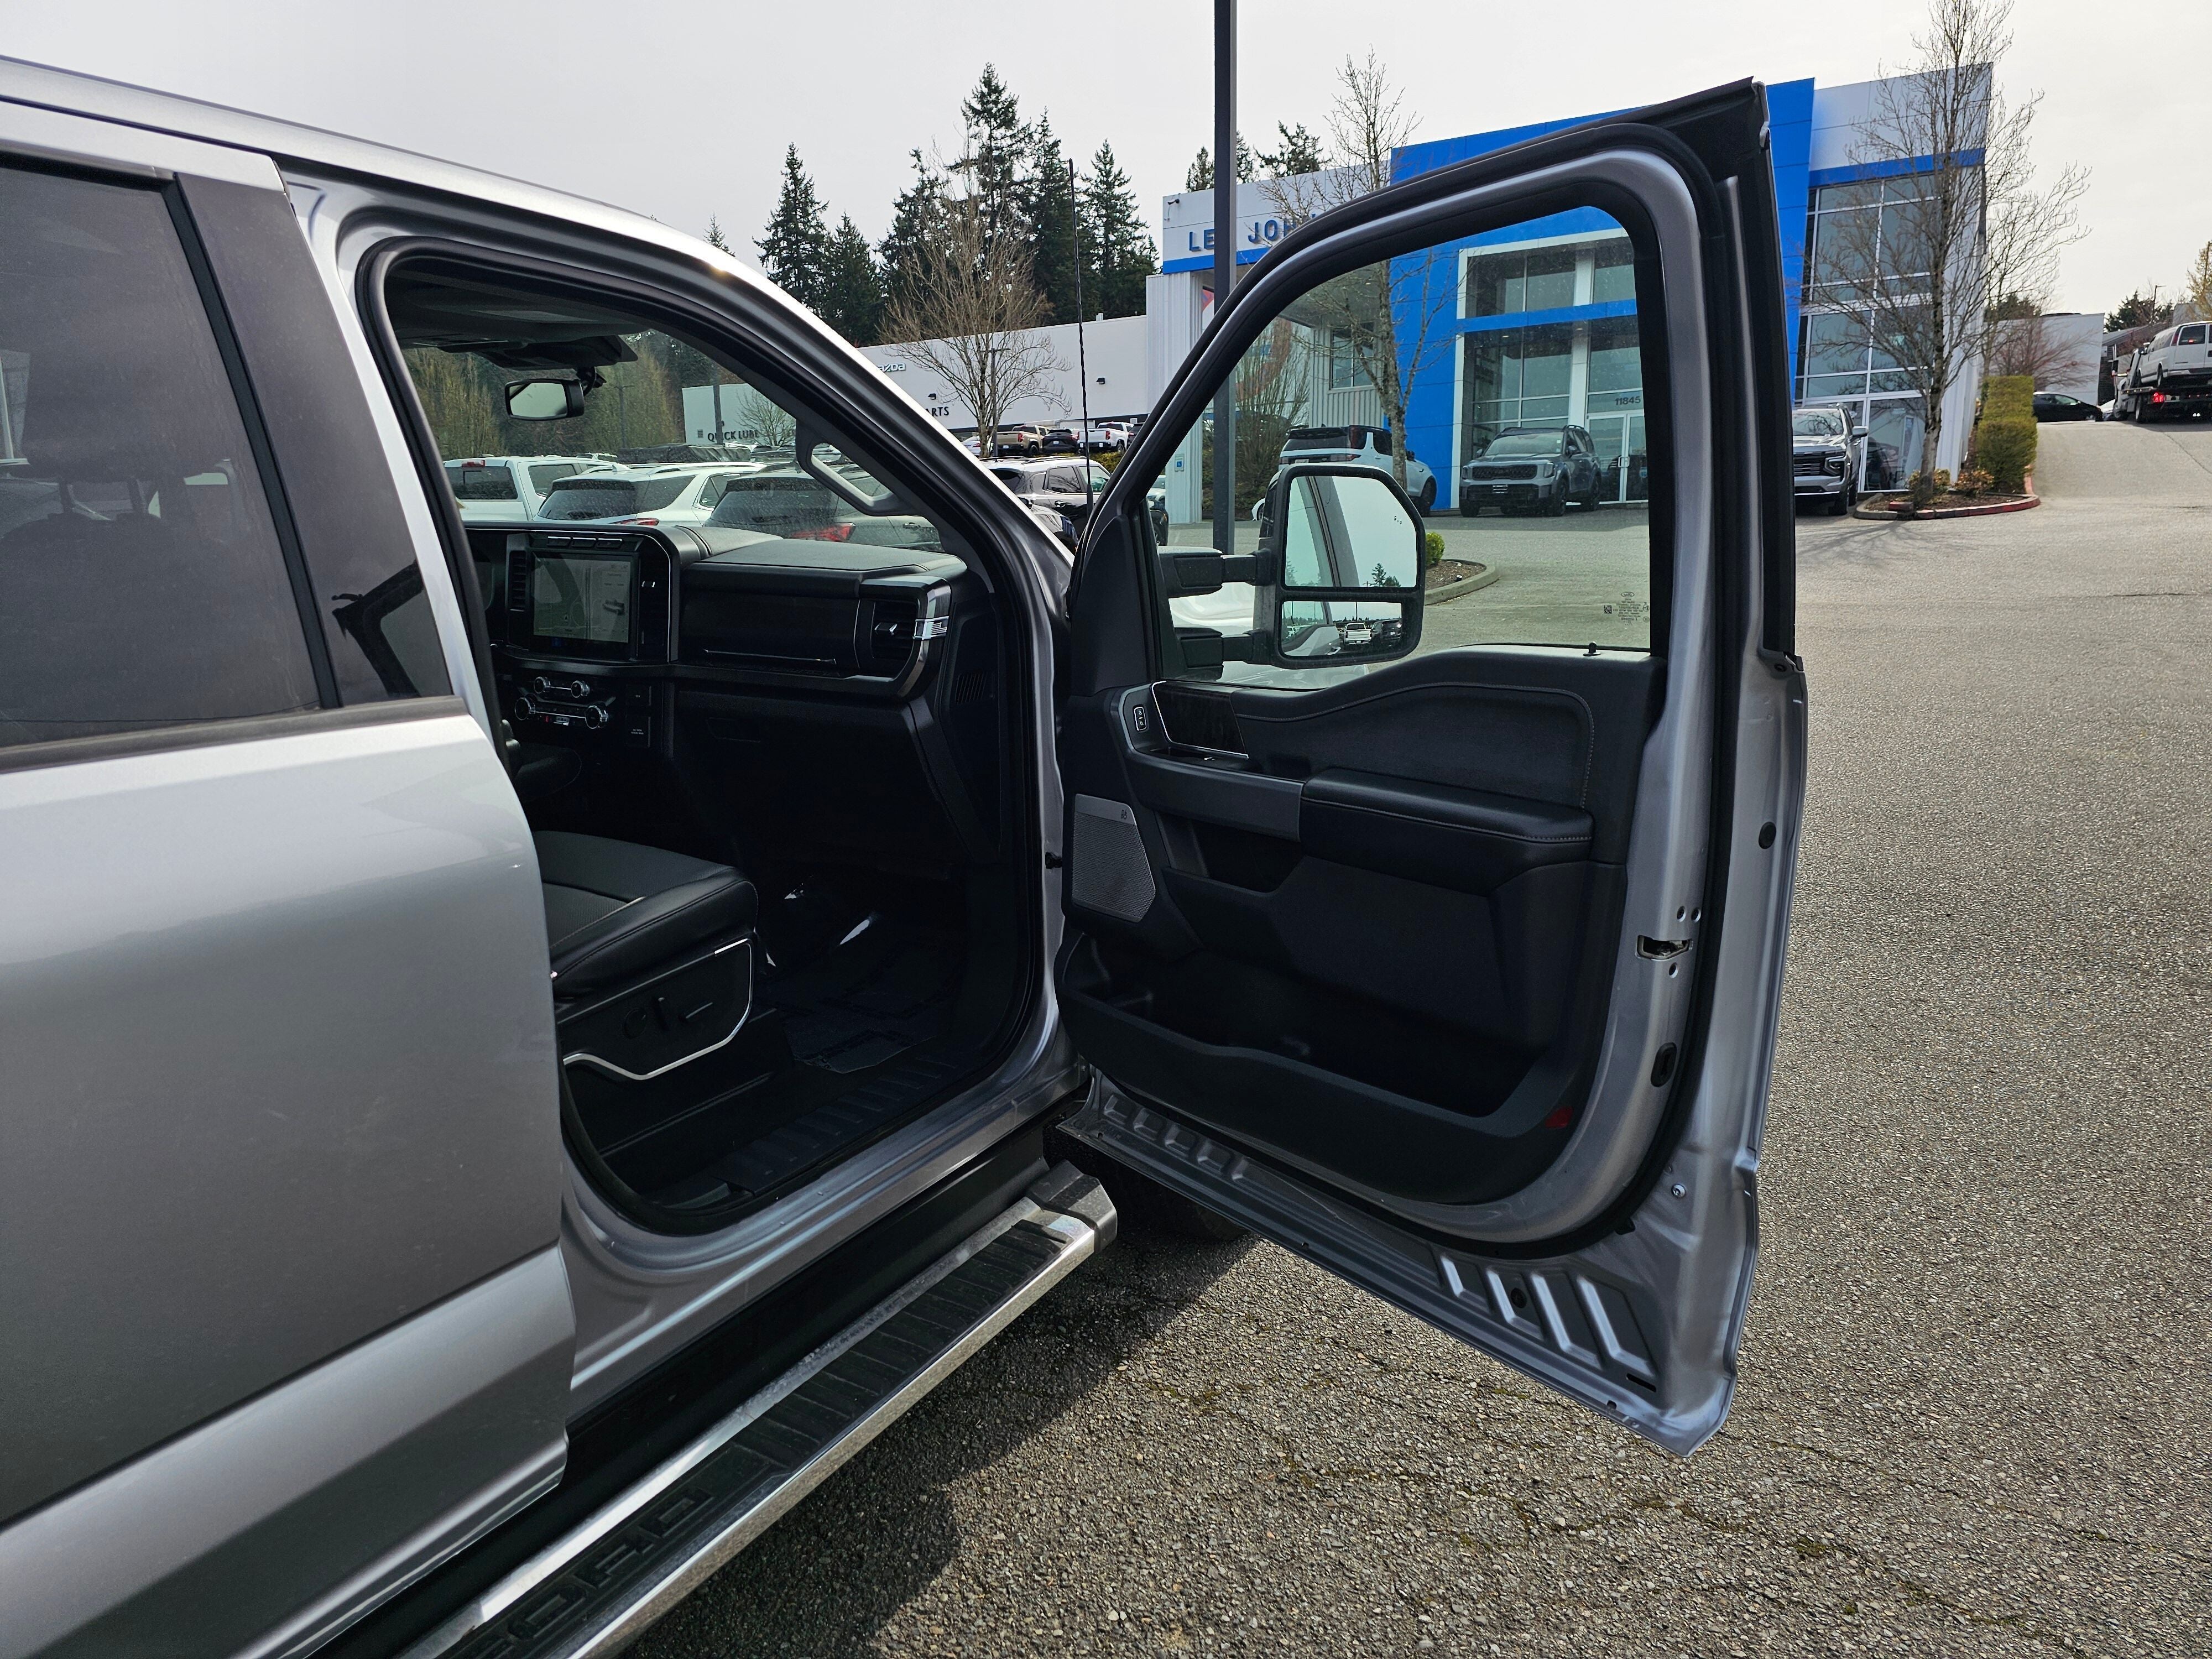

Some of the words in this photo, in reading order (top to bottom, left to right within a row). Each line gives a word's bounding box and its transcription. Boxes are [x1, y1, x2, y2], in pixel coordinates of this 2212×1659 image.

[1189, 228, 1215, 251] LE
[1614, 395, 1641, 405] 11845
[925, 406, 950, 417] RTS
[707, 431, 737, 442] QCK
[738, 430, 760, 439] LUBE
